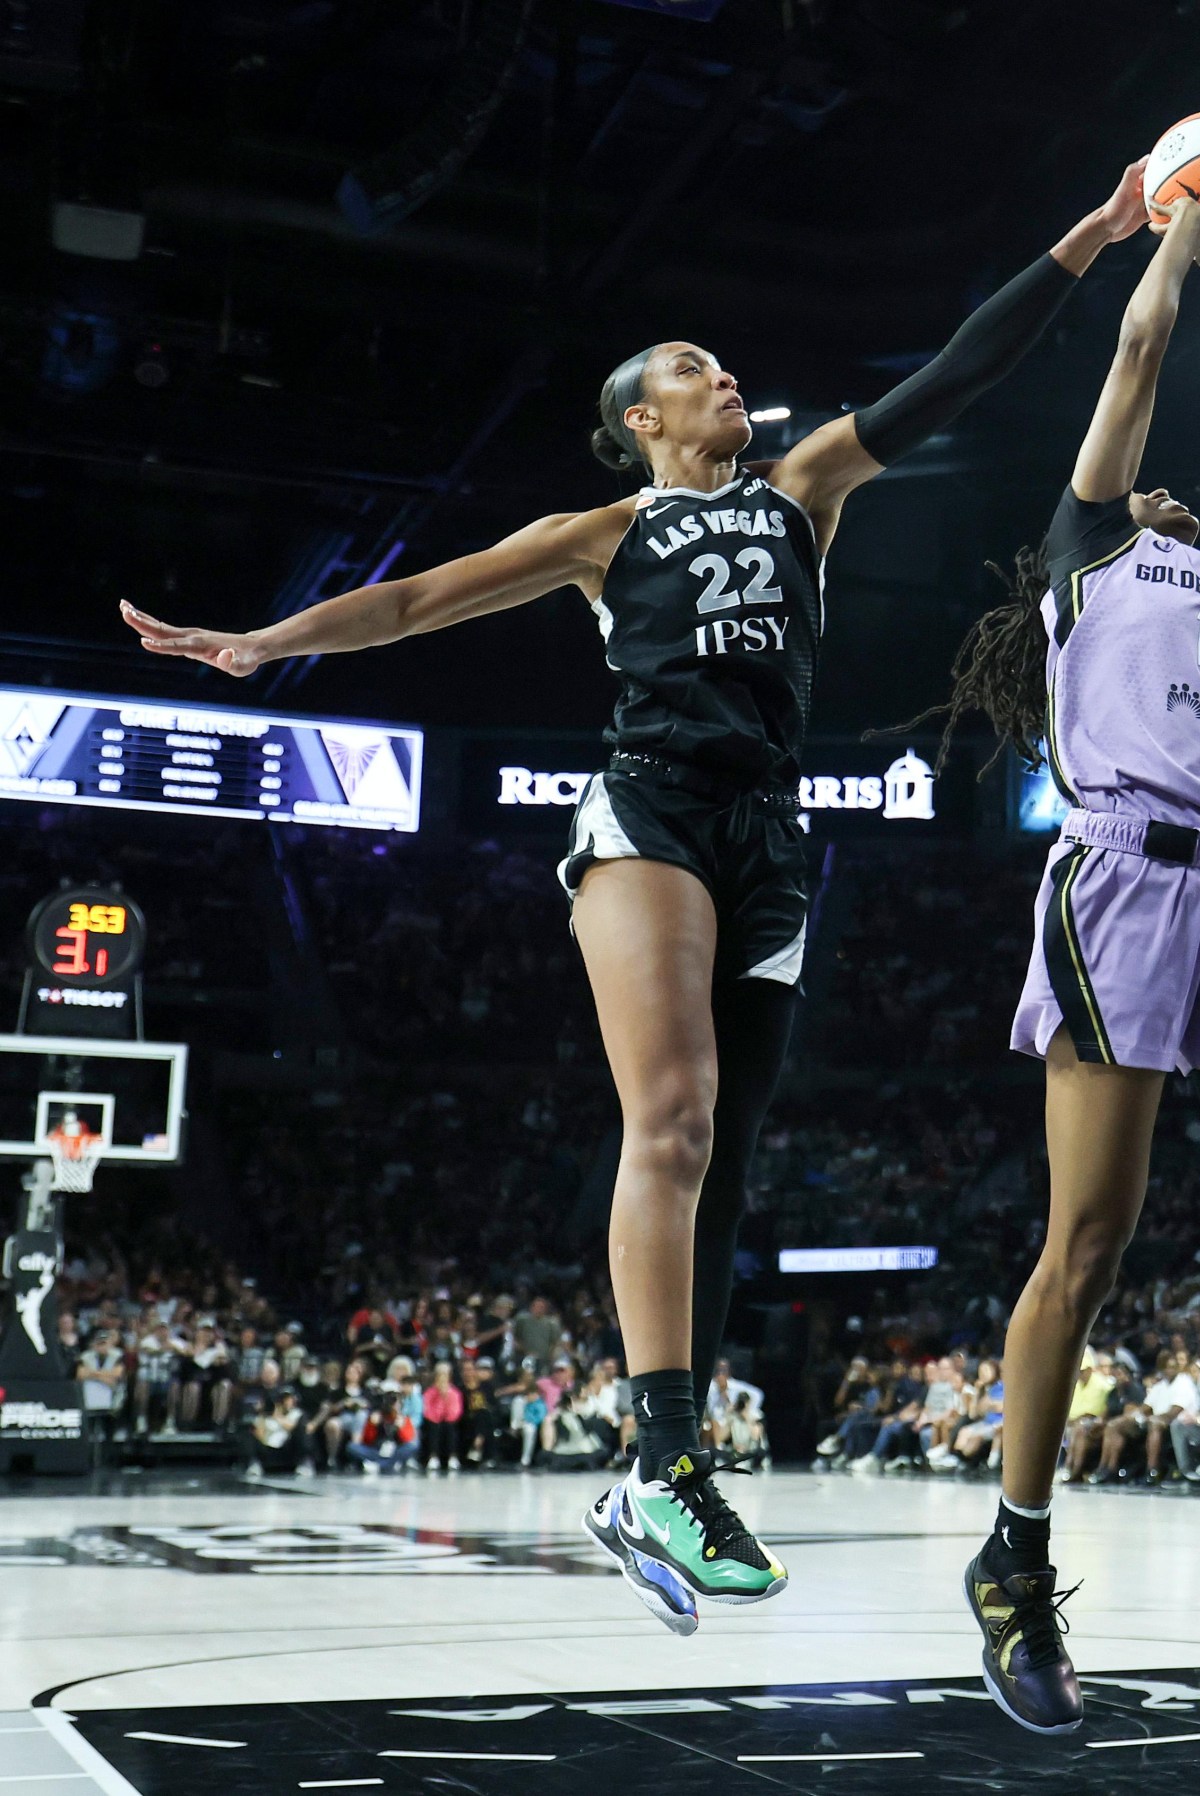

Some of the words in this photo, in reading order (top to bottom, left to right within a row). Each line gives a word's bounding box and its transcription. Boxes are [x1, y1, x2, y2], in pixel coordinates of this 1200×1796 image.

[646, 514, 705, 560] LAS
[700, 508, 787, 538] VEGAS
[688, 546, 784, 615] 22
[695, 616, 790, 657] IPSY
